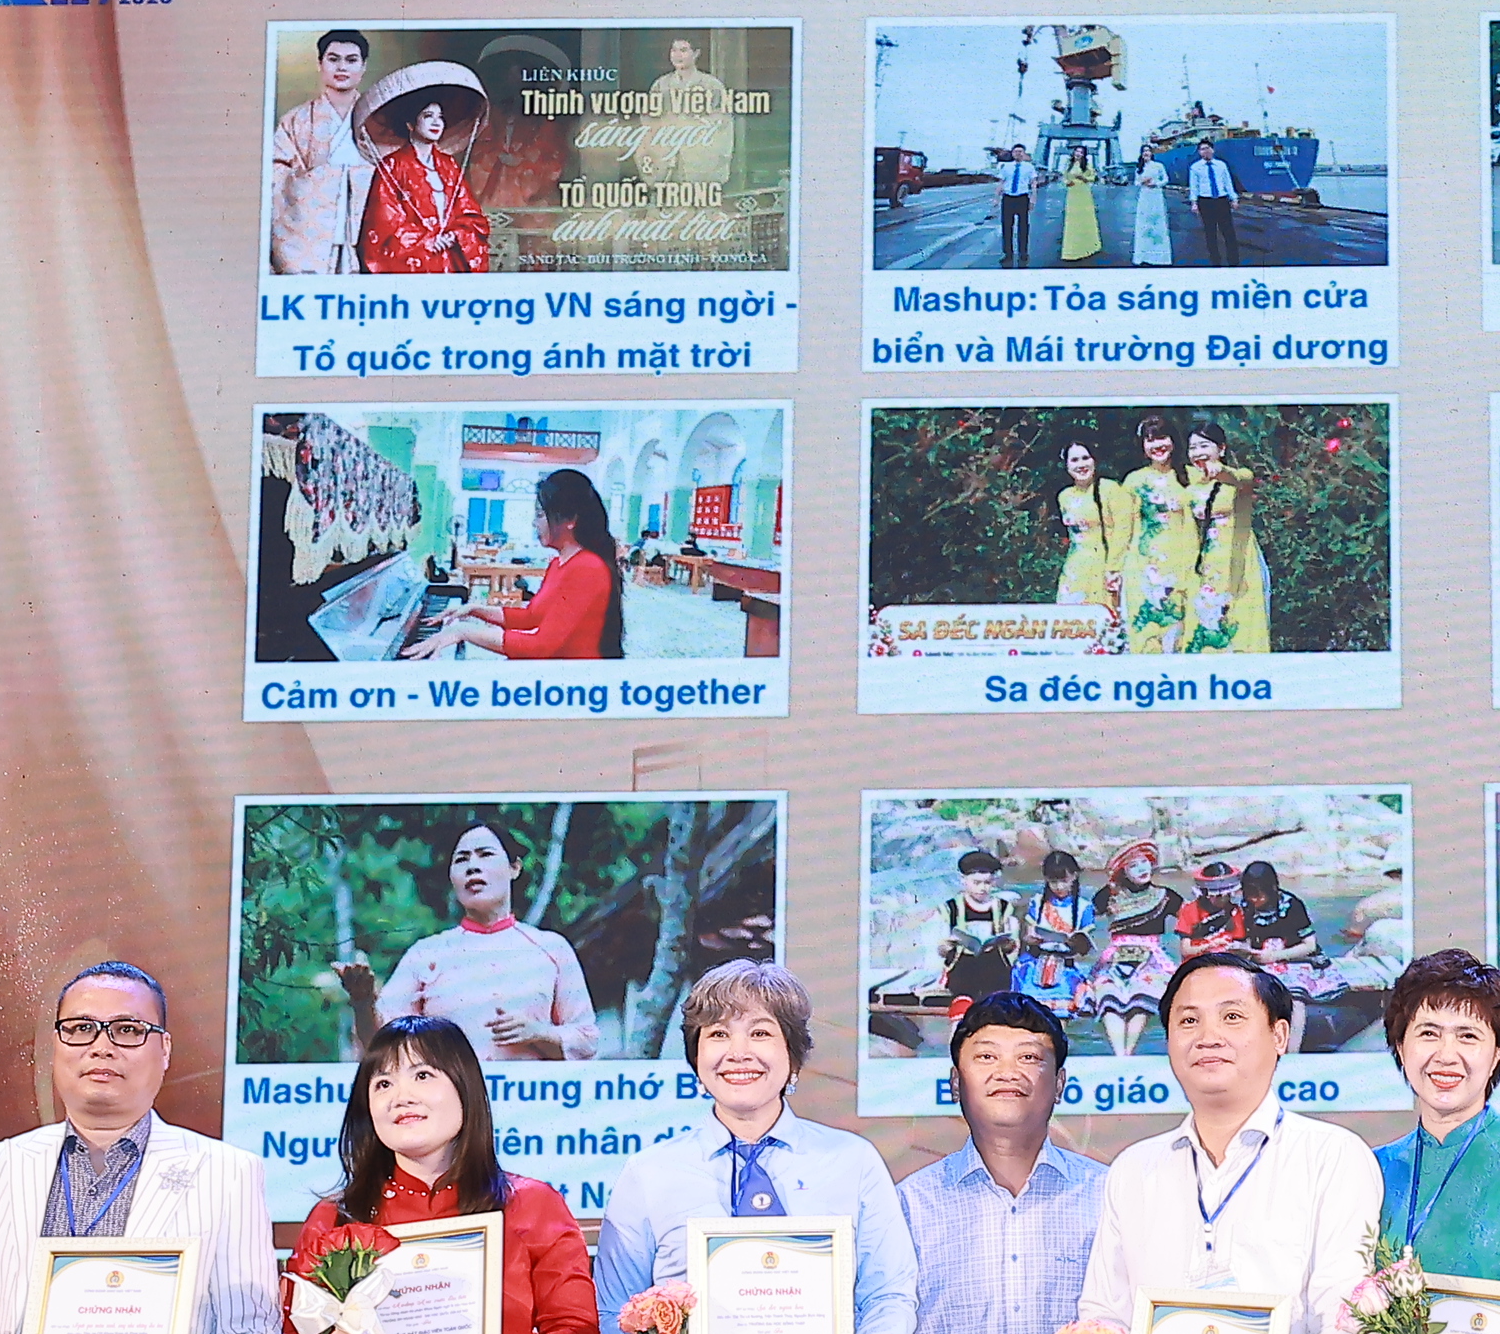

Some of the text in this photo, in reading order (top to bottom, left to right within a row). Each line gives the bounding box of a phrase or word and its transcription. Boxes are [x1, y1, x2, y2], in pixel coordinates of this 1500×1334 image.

[522, 66, 617, 81] LIÊN KHÚC
[522, 86, 770, 120] Thịnh vượng Việt Nam
[575, 117, 721, 161] sáng ngời
[559, 174, 722, 207] TỔ QUỐC TRONG
[260, 294, 305, 321] LK
[313, 293, 409, 327] Thịnh
[420, 298, 535, 326] vượng
[544, 291, 592, 318] VN
[603, 290, 686, 324] sáng
[698, 289, 775, 324] ngời
[893, 278, 1368, 319] Mashup: Tỏa sáng miền cửa
[292, 338, 751, 378] Tổ quốc trong ánh mặt trời
[872, 330, 1388, 368] biển và Mái trường Đại dương
[899, 614, 1097, 641] SA ĐÉC NGÀN HOA
[261, 679, 338, 710] Cảm
[349, 687, 396, 709] ơn
[428, 680, 480, 708] We
[491, 679, 608, 714] belong
[619, 677, 766, 713] together
[985, 672, 1272, 709] Sa đéc ngàn hoa
[243, 1076, 352, 1104] Mashu
[484, 1074, 582, 1109] Trung
[594, 1072, 665, 1101] nhớ
[1094, 1075, 1170, 1112] giáo
[1277, 1080, 1340, 1103] cao
[263, 1130, 337, 1164] Ngư
[494, 1128, 550, 1155] iên
[556, 1126, 642, 1156] nhân
[395, 1281, 451, 1295] HỨNG NHẬN
[738, 1287, 802, 1298] CHỨNG NHẬN
[77, 1305, 142, 1316] CHỨNG NHẬN
